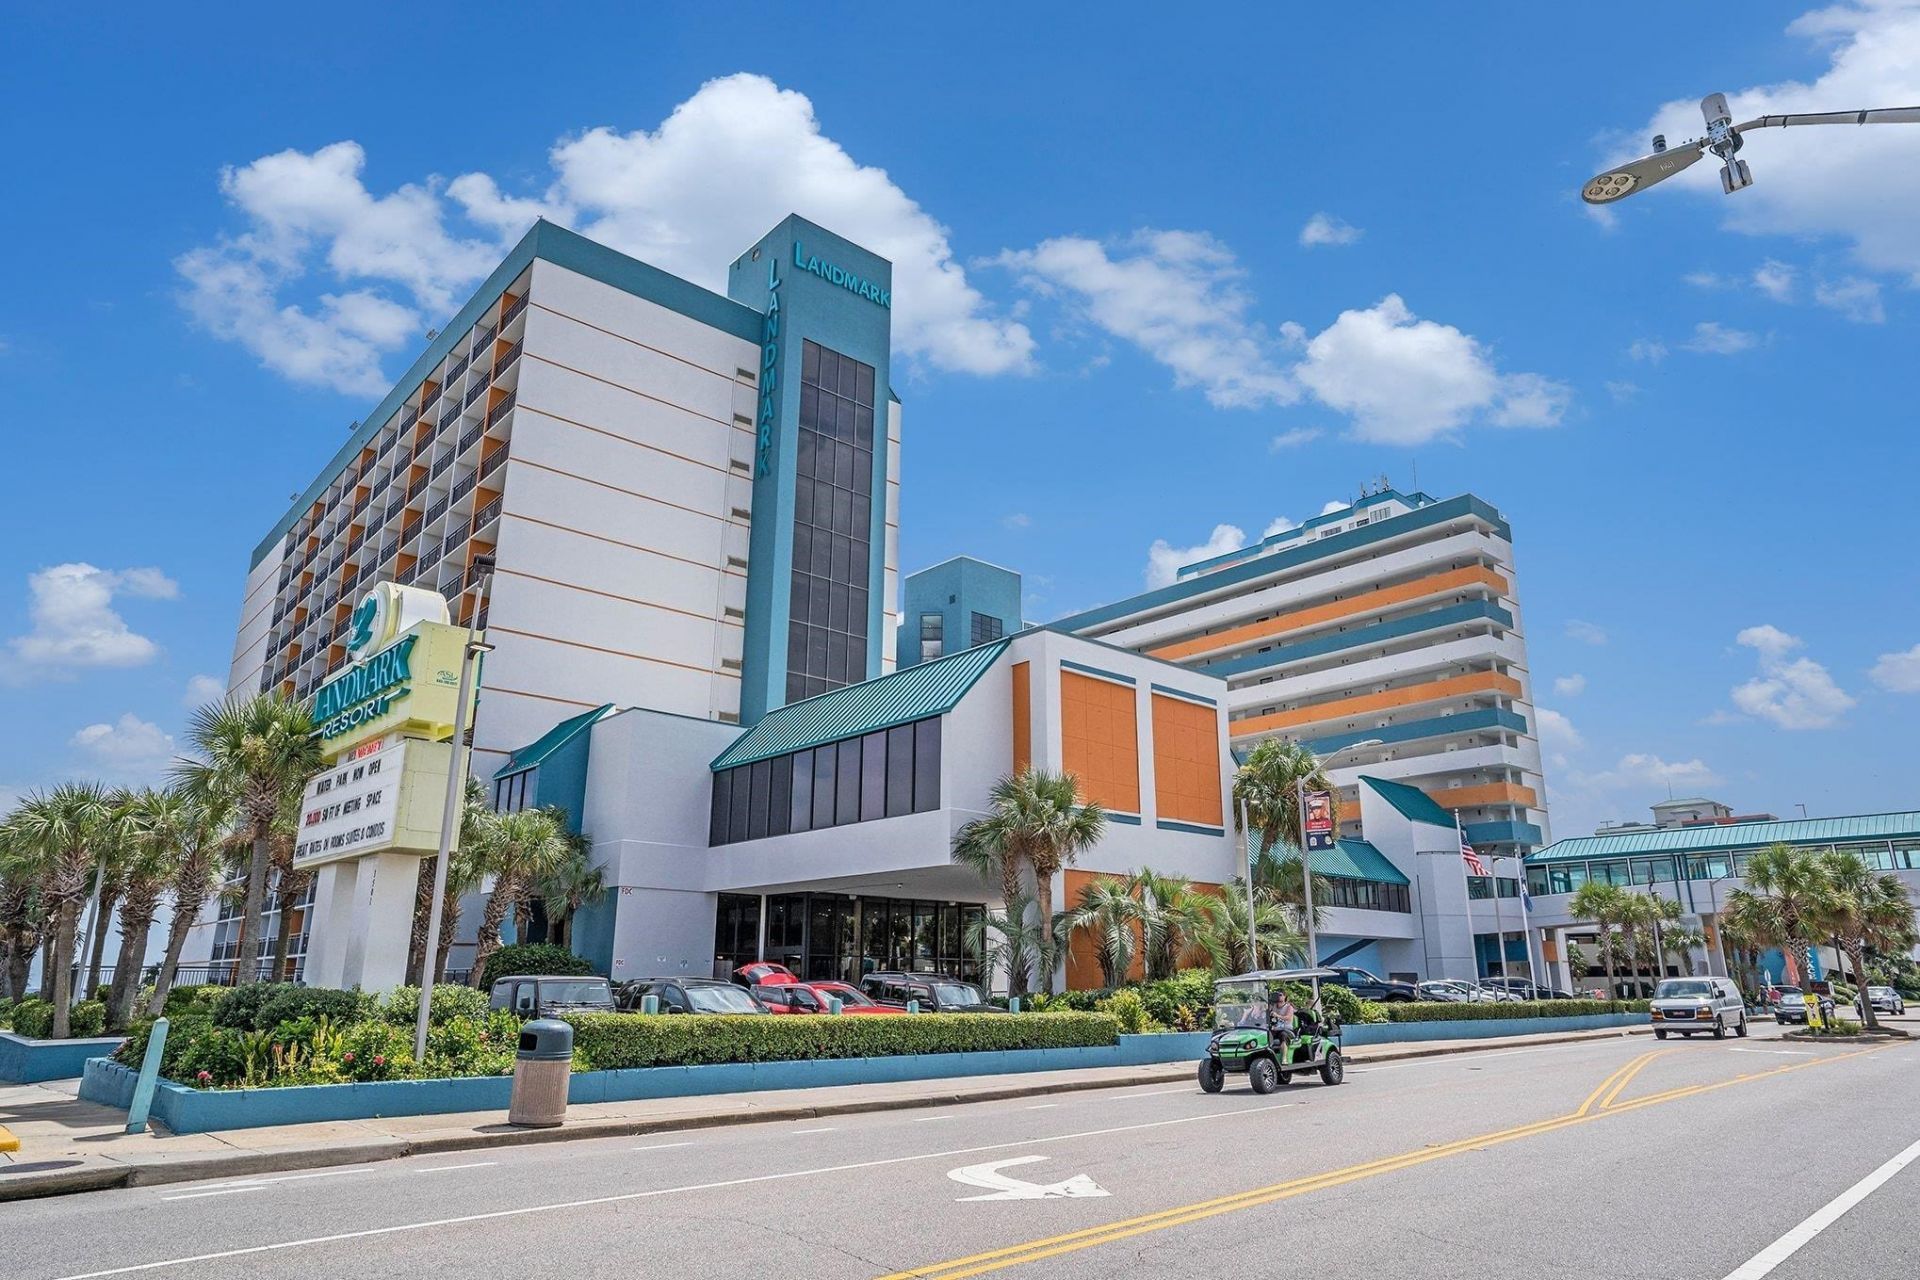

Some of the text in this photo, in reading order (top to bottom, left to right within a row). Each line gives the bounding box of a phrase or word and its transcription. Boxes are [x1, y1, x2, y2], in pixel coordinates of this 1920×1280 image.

[795, 240, 890, 308] LANDMARK
[758, 258, 780, 479] LANDMARK
[313, 639, 408, 722] LANDMARK
[322, 694, 388, 739] RESORT
[316, 759, 381, 795] WATER PARK NOW OPEN
[343, 797, 361, 816] MEETING
[366, 790, 382, 808] SPACE
[330, 831, 345, 848] ROOMS
[365, 822, 385, 839] CONDOS
